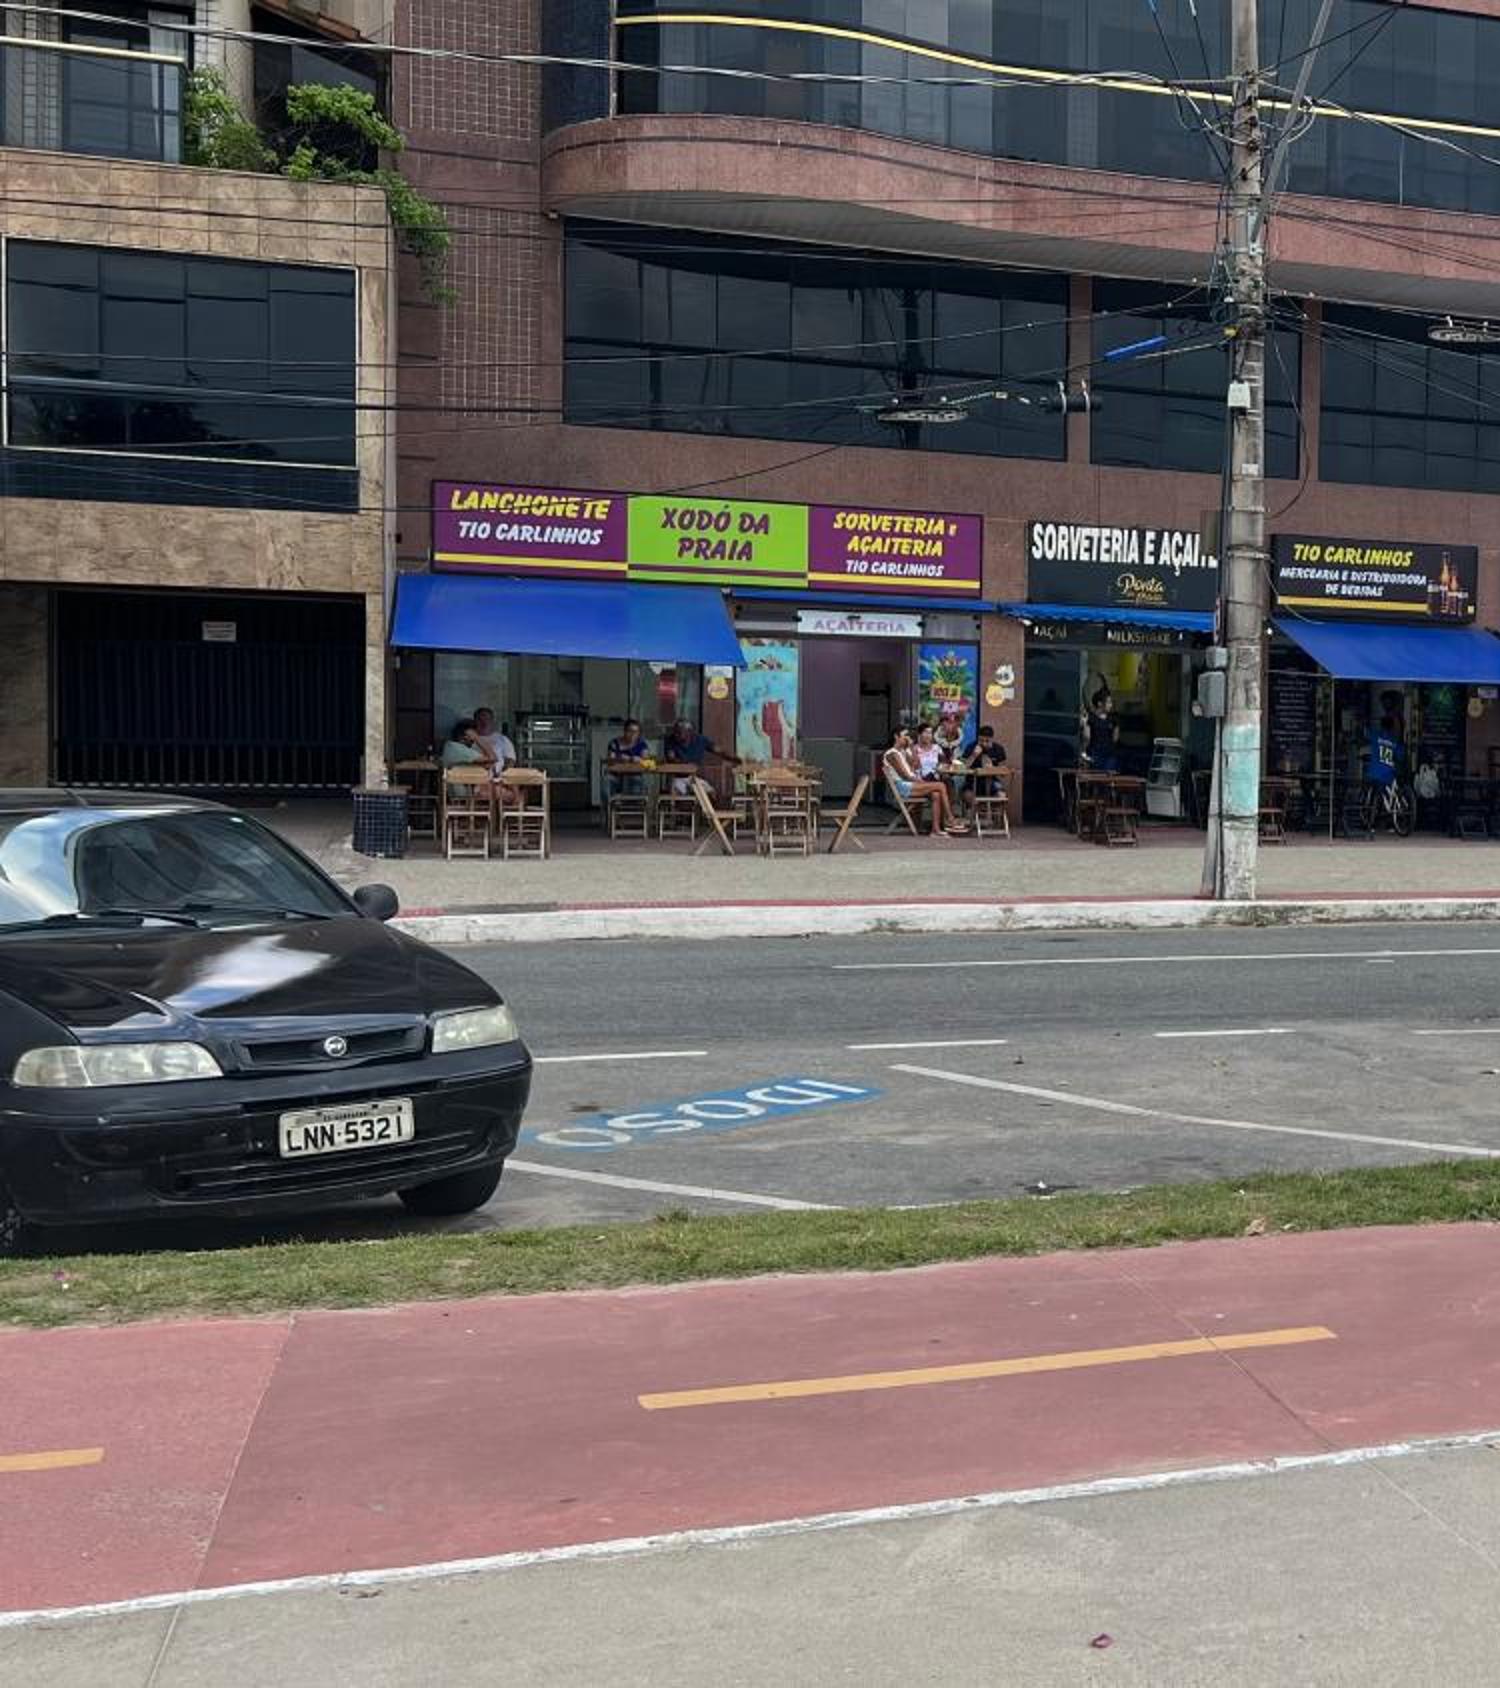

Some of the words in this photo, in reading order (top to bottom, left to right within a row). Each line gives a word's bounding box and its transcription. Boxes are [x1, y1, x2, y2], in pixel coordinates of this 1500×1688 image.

[451, 489, 611, 520] LANCHONETE
[458, 520, 491, 540] TIO
[495, 522, 604, 546] CARLINHOS
[661, 504, 731, 534] XODÓ
[738, 511, 770, 536] DA
[833, 511, 945, 537] SORVETERIA
[677, 536, 753, 562] PRAIA
[847, 536, 943, 558] AÇAITERIA
[1031, 522, 1139, 565] SORVETERIA
[1143, 530, 1156, 565] E
[1159, 531, 1218, 577] AÇAI
[1293, 543, 1322, 562] TIO
[1324, 545, 1413, 568] CARLINHOS
[845, 558, 868, 574] TIO
[871, 560, 944, 577] CARLINHOS
[1280, 567, 1339, 581] MERCEARIA
[1341, 569, 1348, 581] E
[1350, 570, 1427, 586] DISTRIBUIDORA
[1117, 573, 1164, 594] Ponta
[1325, 583, 1339, 595] DE
[1341, 584, 1384, 597] BEBIDAS
[536, 1078, 867, 1147] IDOSO
